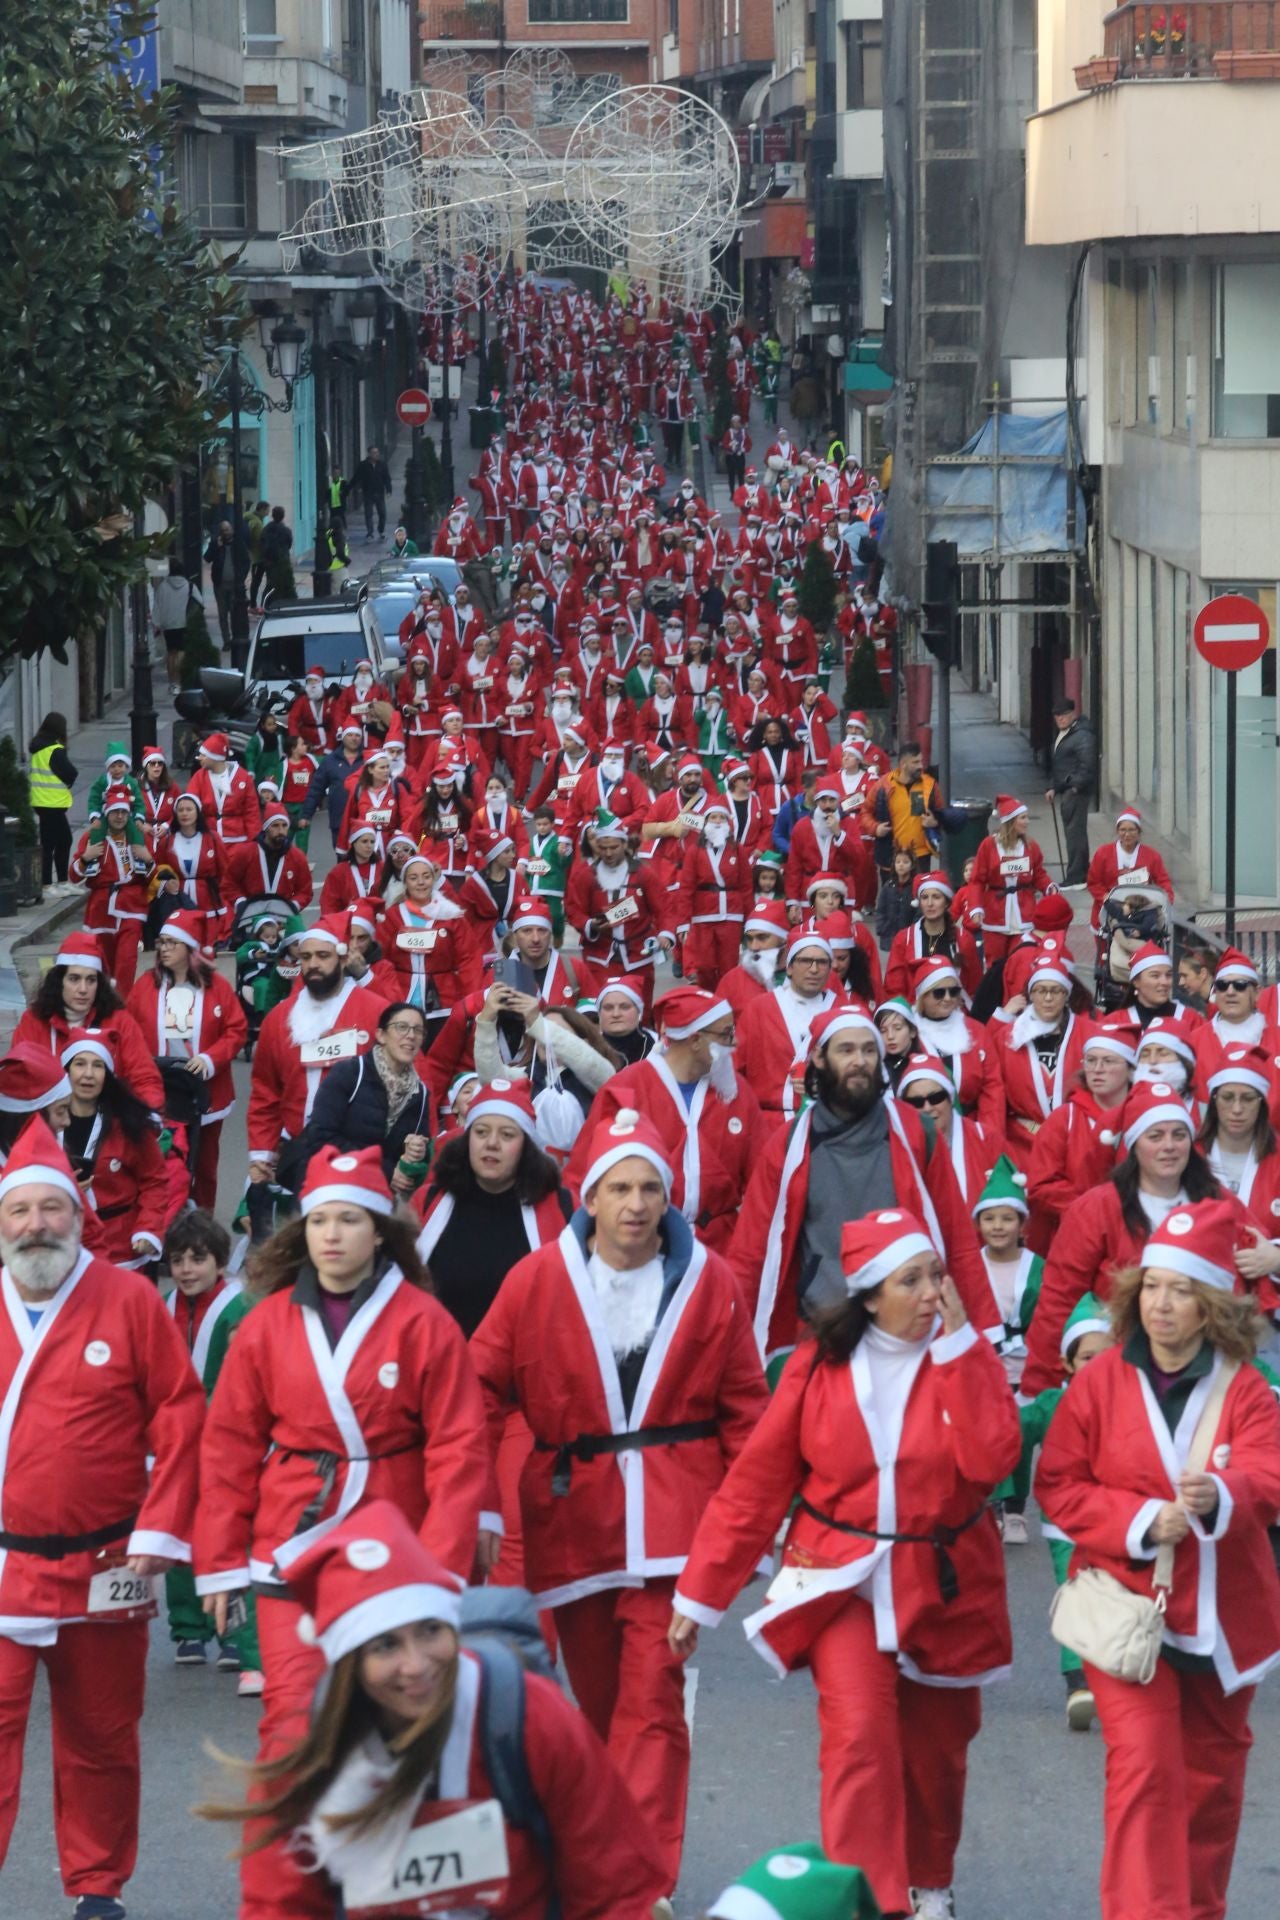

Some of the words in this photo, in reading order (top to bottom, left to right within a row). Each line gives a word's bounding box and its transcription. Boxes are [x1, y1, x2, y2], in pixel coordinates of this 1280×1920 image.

[685, 816, 699, 827] 1784
[1007, 864, 1023, 872] 1786
[614, 908, 629, 919] 635
[407, 937, 424, 946] 636
[317, 1045, 341, 1057] 945
